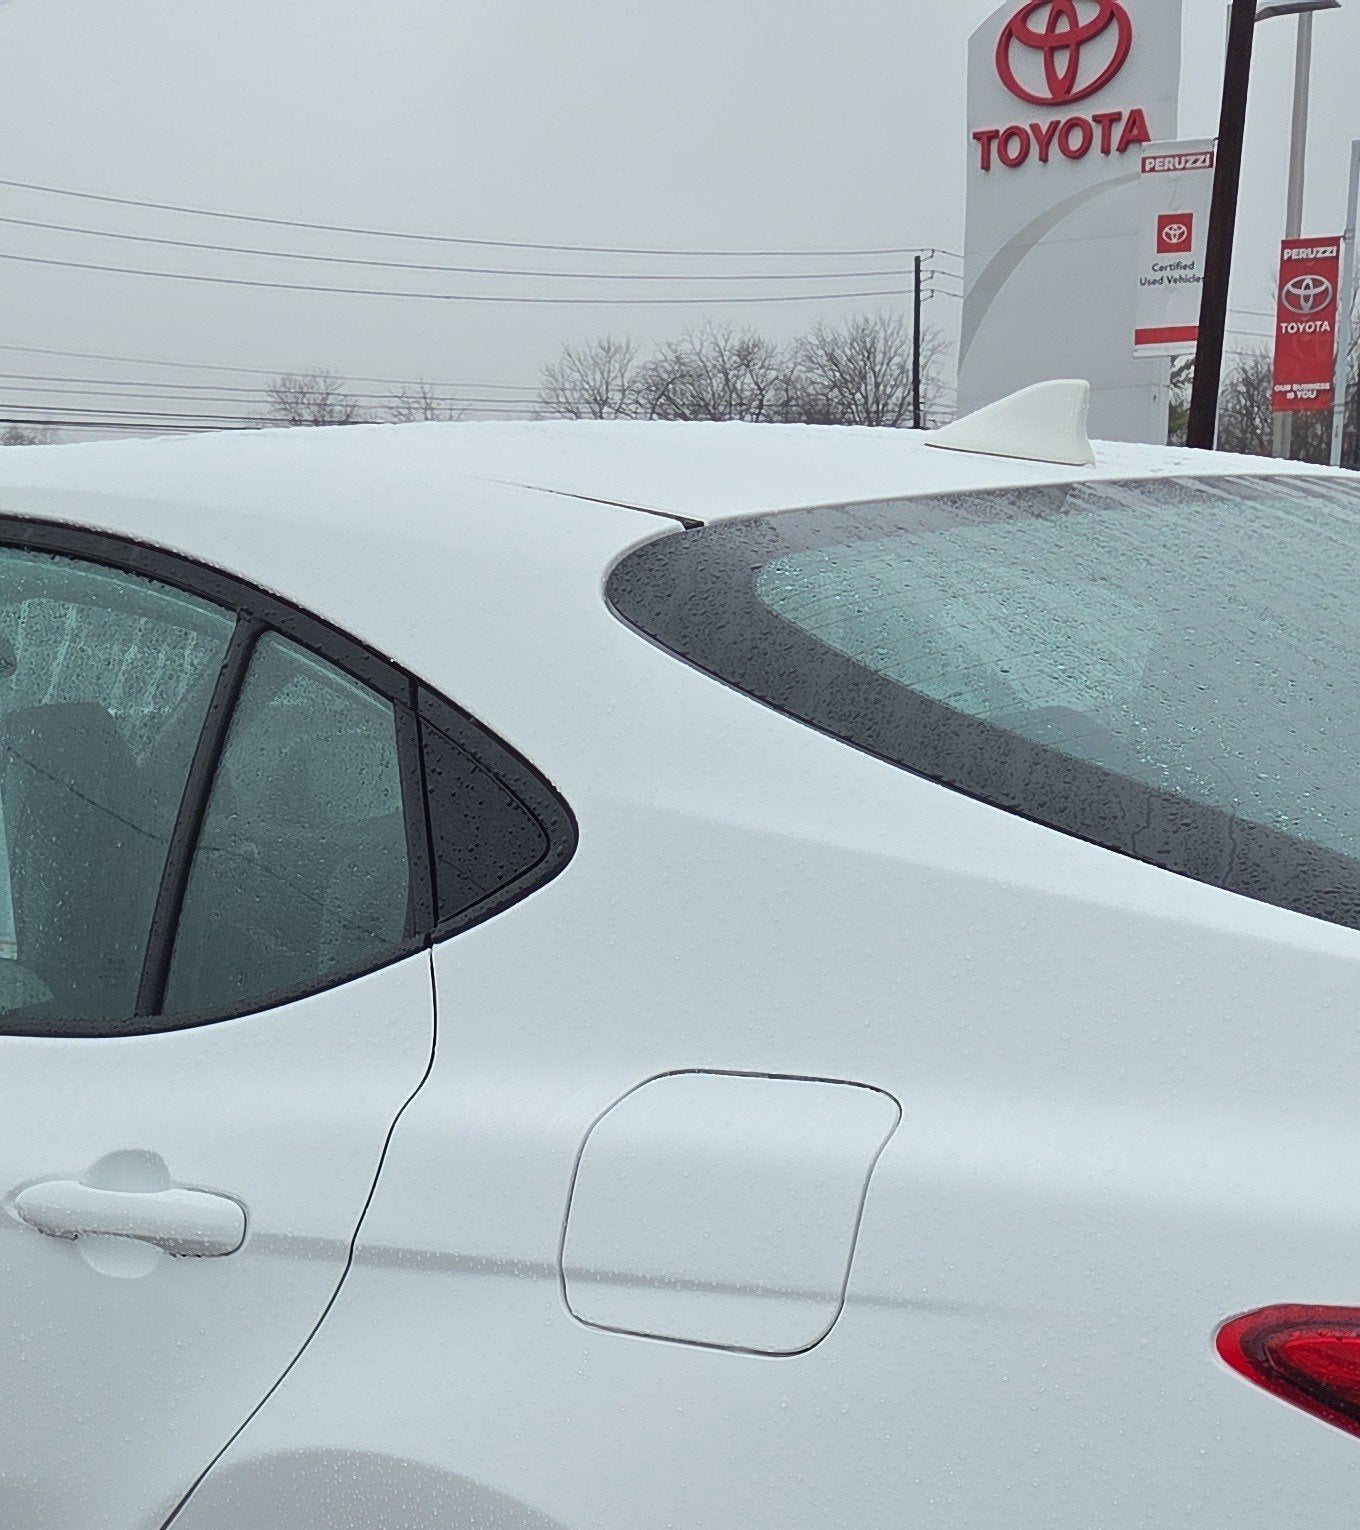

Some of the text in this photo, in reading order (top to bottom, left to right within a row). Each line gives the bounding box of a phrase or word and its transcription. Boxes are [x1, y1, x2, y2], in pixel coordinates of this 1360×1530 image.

[972, 108, 1151, 171] TOYOTA
[1145, 153, 1211, 171] PERUZZI
[1283, 245, 1337, 260] PERUZZI
[1151, 260, 1195, 273] Certified
[1140, 275, 1164, 286] Used
[1280, 321, 1331, 334] TOYOTA
[1297, 389, 1317, 399] YOU
